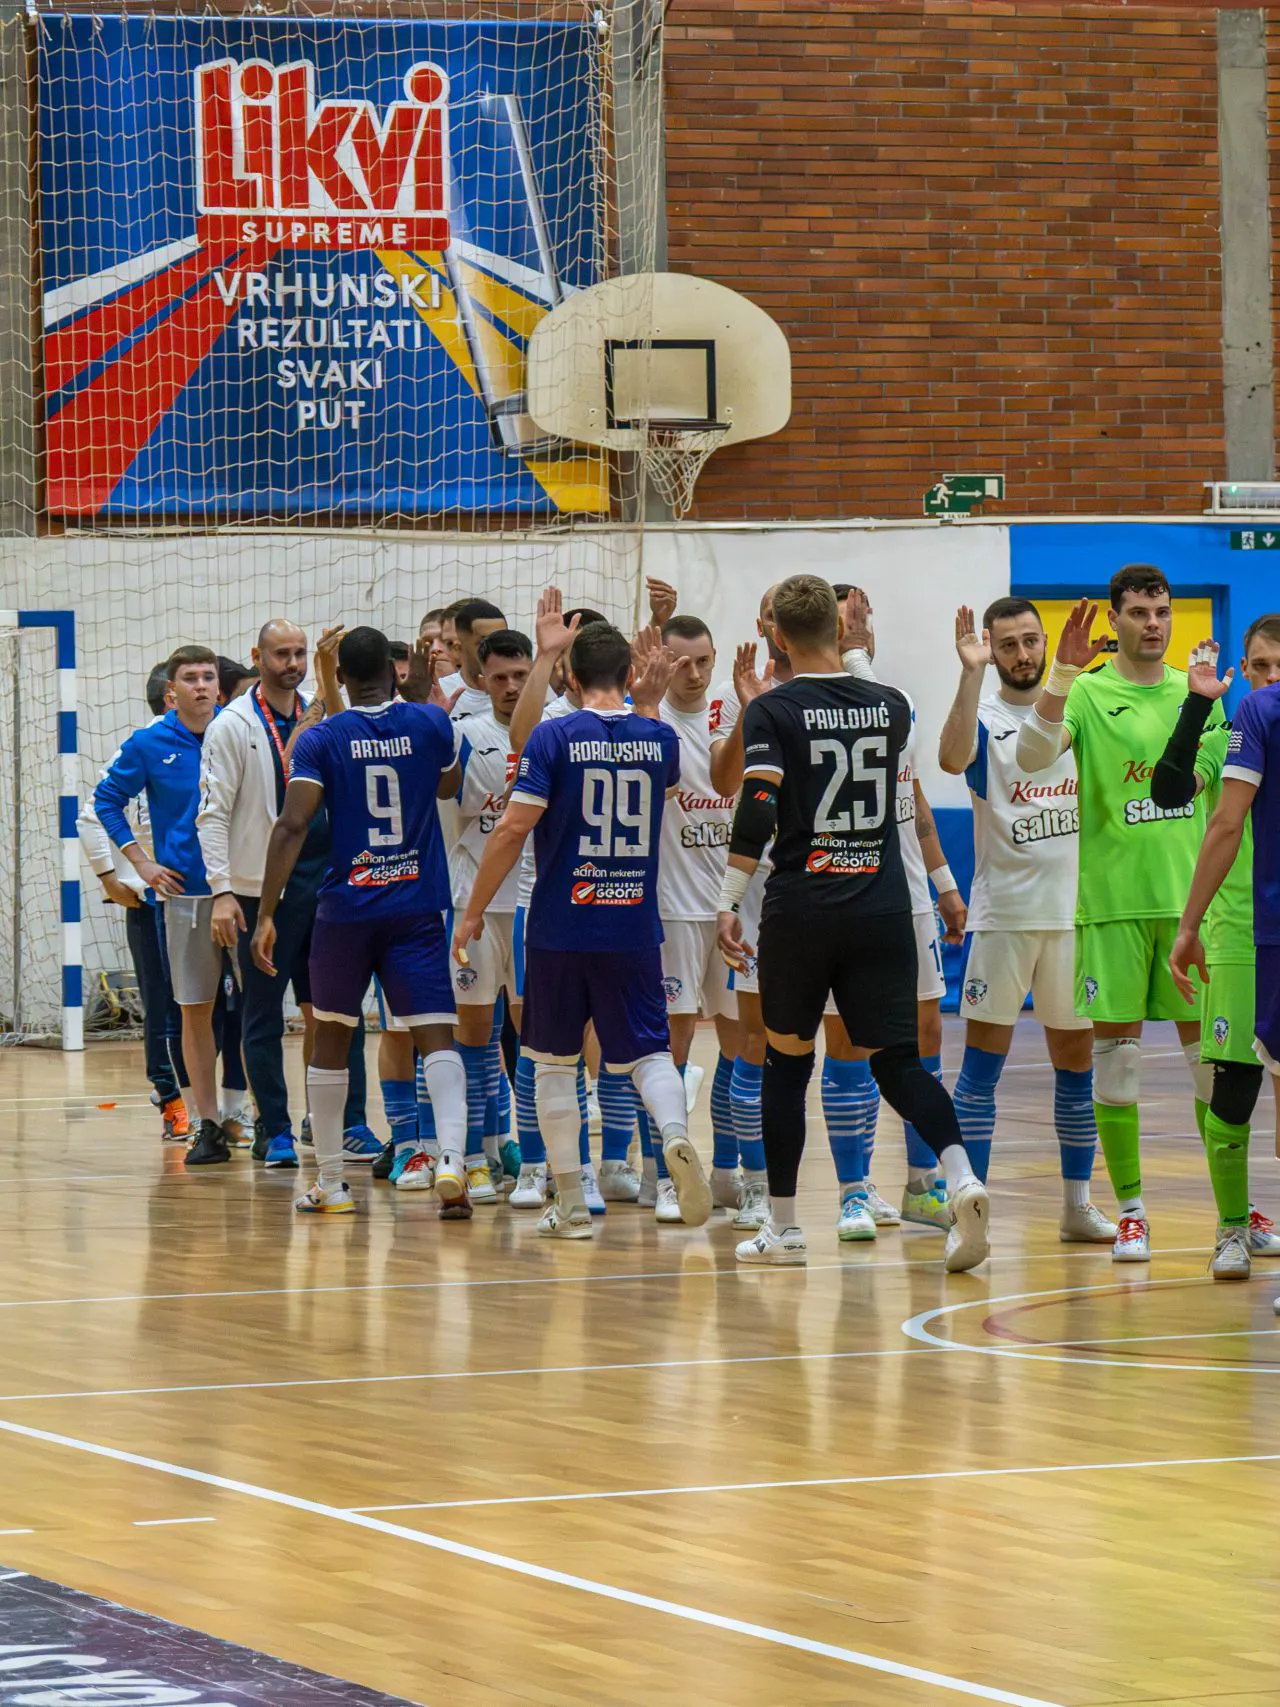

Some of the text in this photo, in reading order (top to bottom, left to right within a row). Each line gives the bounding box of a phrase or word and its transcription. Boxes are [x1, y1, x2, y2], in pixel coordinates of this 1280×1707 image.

[242, 222, 407, 245] SUPREME
[213, 272, 440, 308] VRHUNSKI
[238, 319, 422, 348] REZULTATI
[277, 359, 382, 389] SVAKI
[299, 400, 366, 430] PUT
[803, 701, 890, 730] PAVLOVIĆ
[350, 736, 413, 759] ARTHUR
[569, 740, 663, 763] KOROLYSHYN
[810, 736, 887, 833] 25
[365, 765, 403, 847] 9
[578, 768, 652, 857] 99
